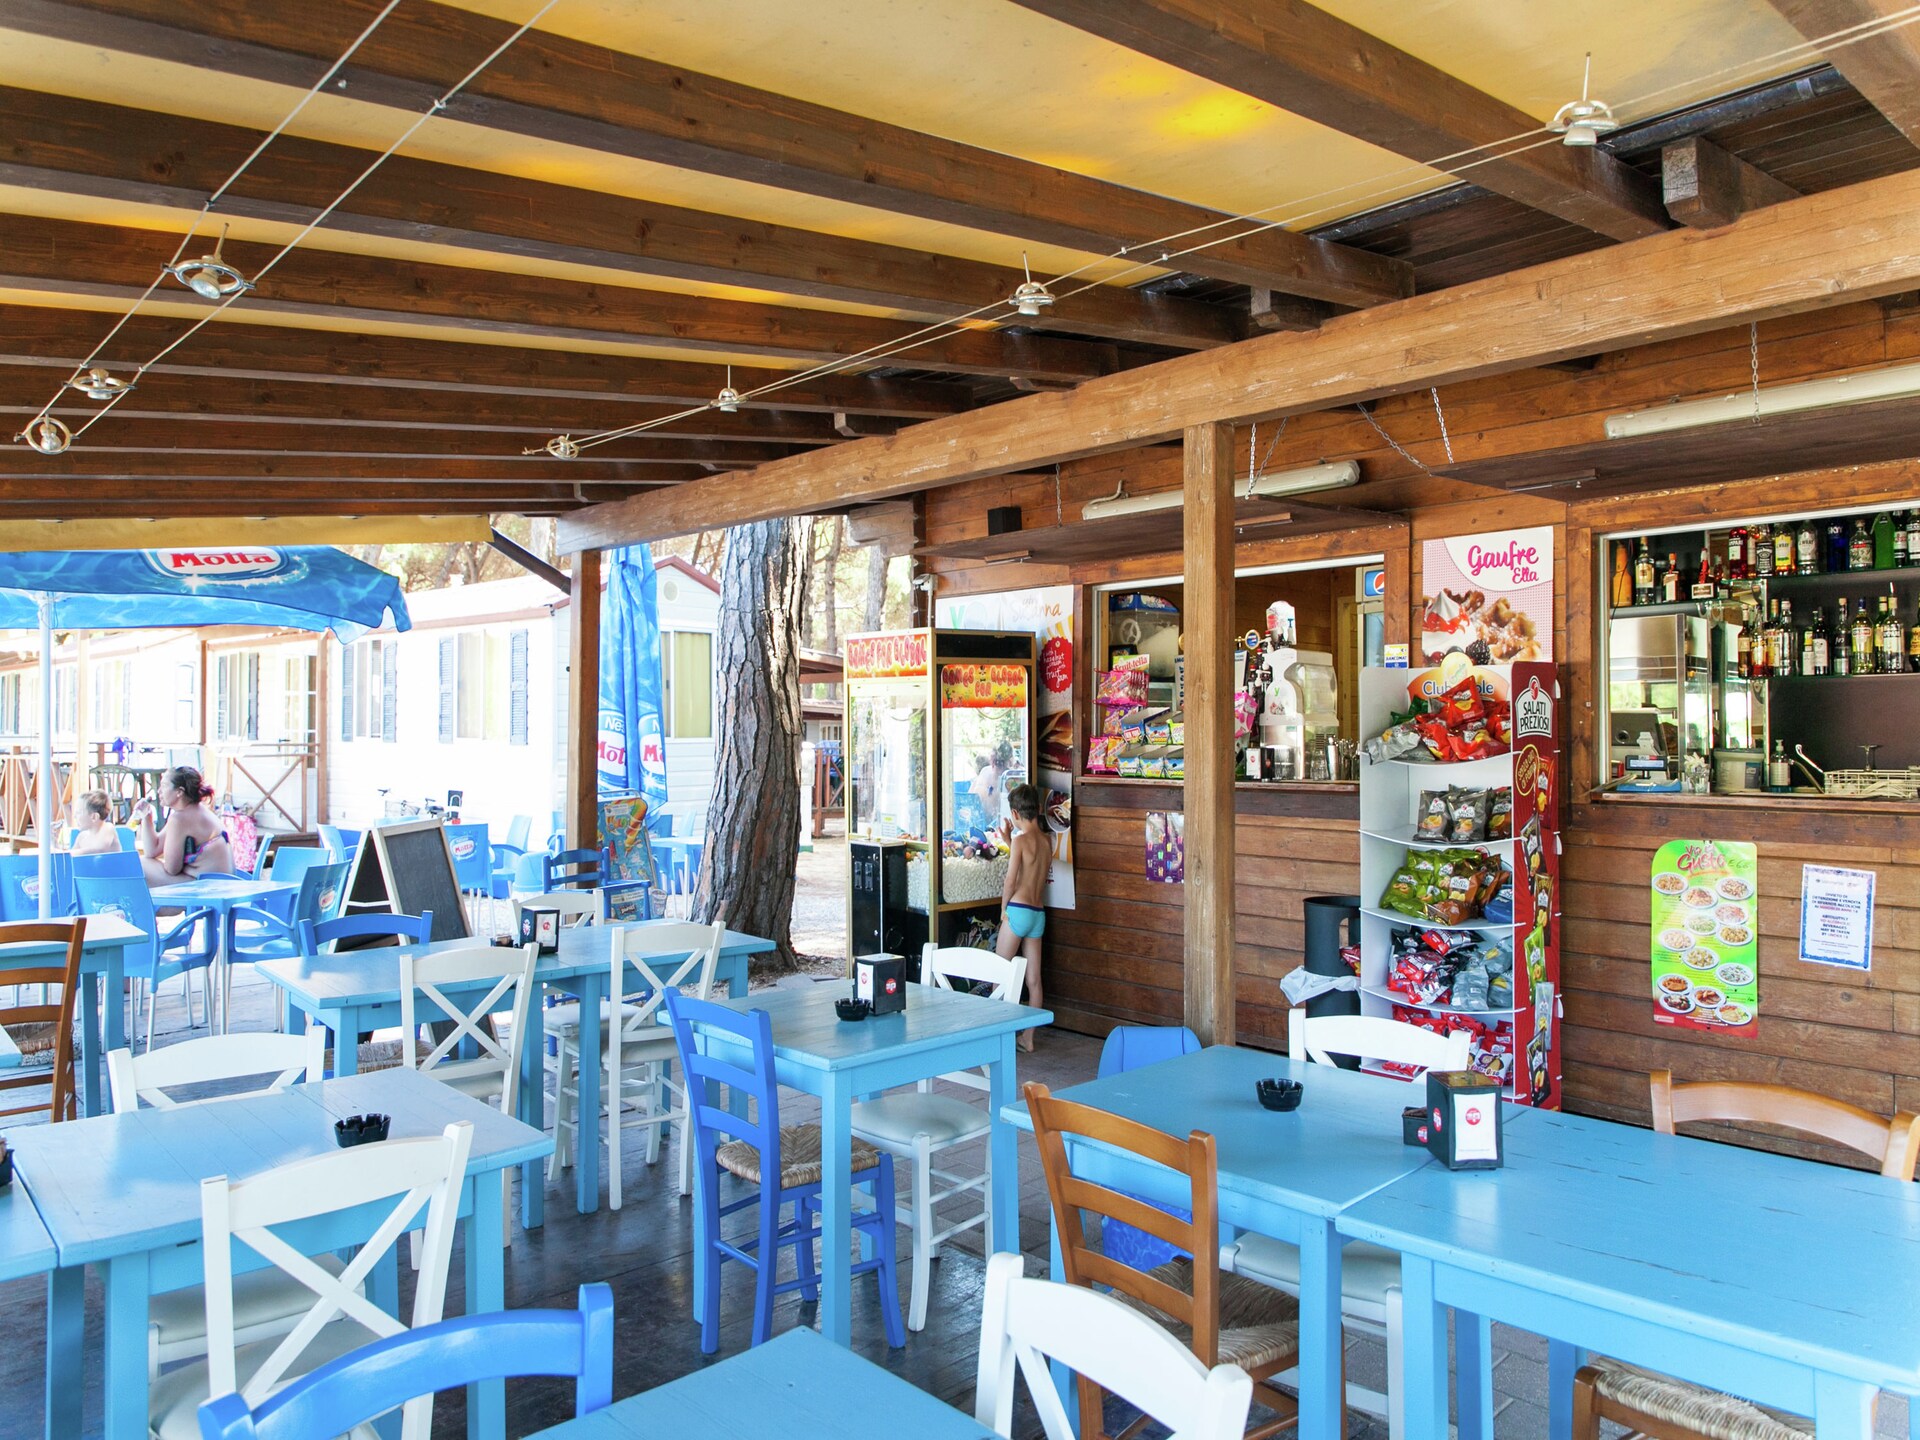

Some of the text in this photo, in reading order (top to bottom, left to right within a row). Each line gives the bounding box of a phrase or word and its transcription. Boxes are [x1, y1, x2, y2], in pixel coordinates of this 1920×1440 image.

[170, 552, 276, 568] Motta
[1468, 540, 1539, 576] Gaufre
[1512, 567, 1539, 584] Ella
[1523, 701, 1546, 716] SALATI
[1520, 715, 1550, 732] PREZIOSI
